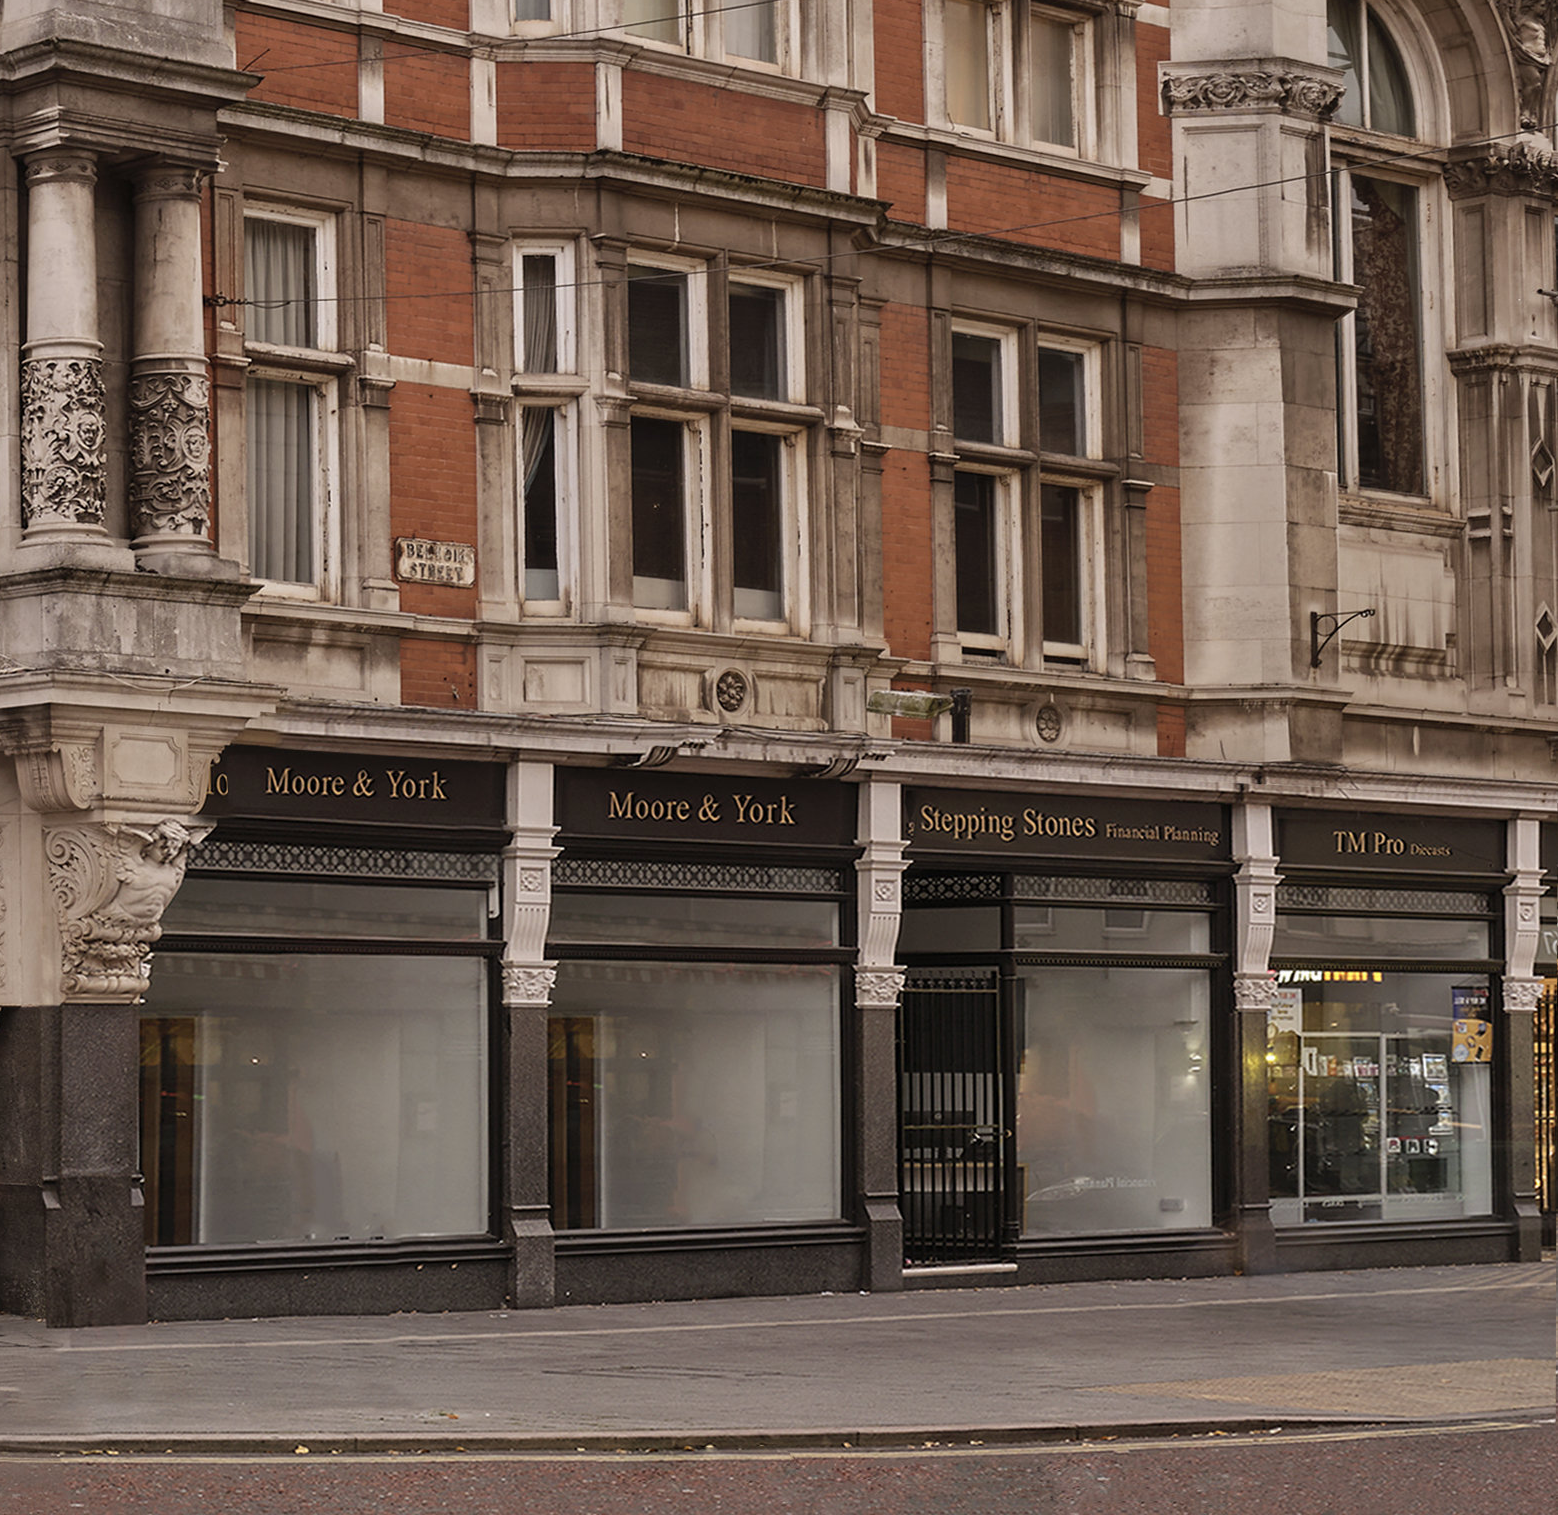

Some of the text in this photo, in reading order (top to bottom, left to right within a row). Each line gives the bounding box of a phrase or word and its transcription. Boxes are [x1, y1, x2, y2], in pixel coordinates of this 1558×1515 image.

[410, 562, 463, 581] STREET
[266, 767, 447, 799] Moore & York
[608, 791, 795, 824] Moore & York
[920, 805, 1013, 841] Stepping
[1023, 808, 1096, 837] Stones
[1106, 823, 1160, 841] Financial
[1164, 826, 1220, 846] Planning
[1333, 831, 1366, 853] TM
[1374, 832, 1405, 855] Pro
